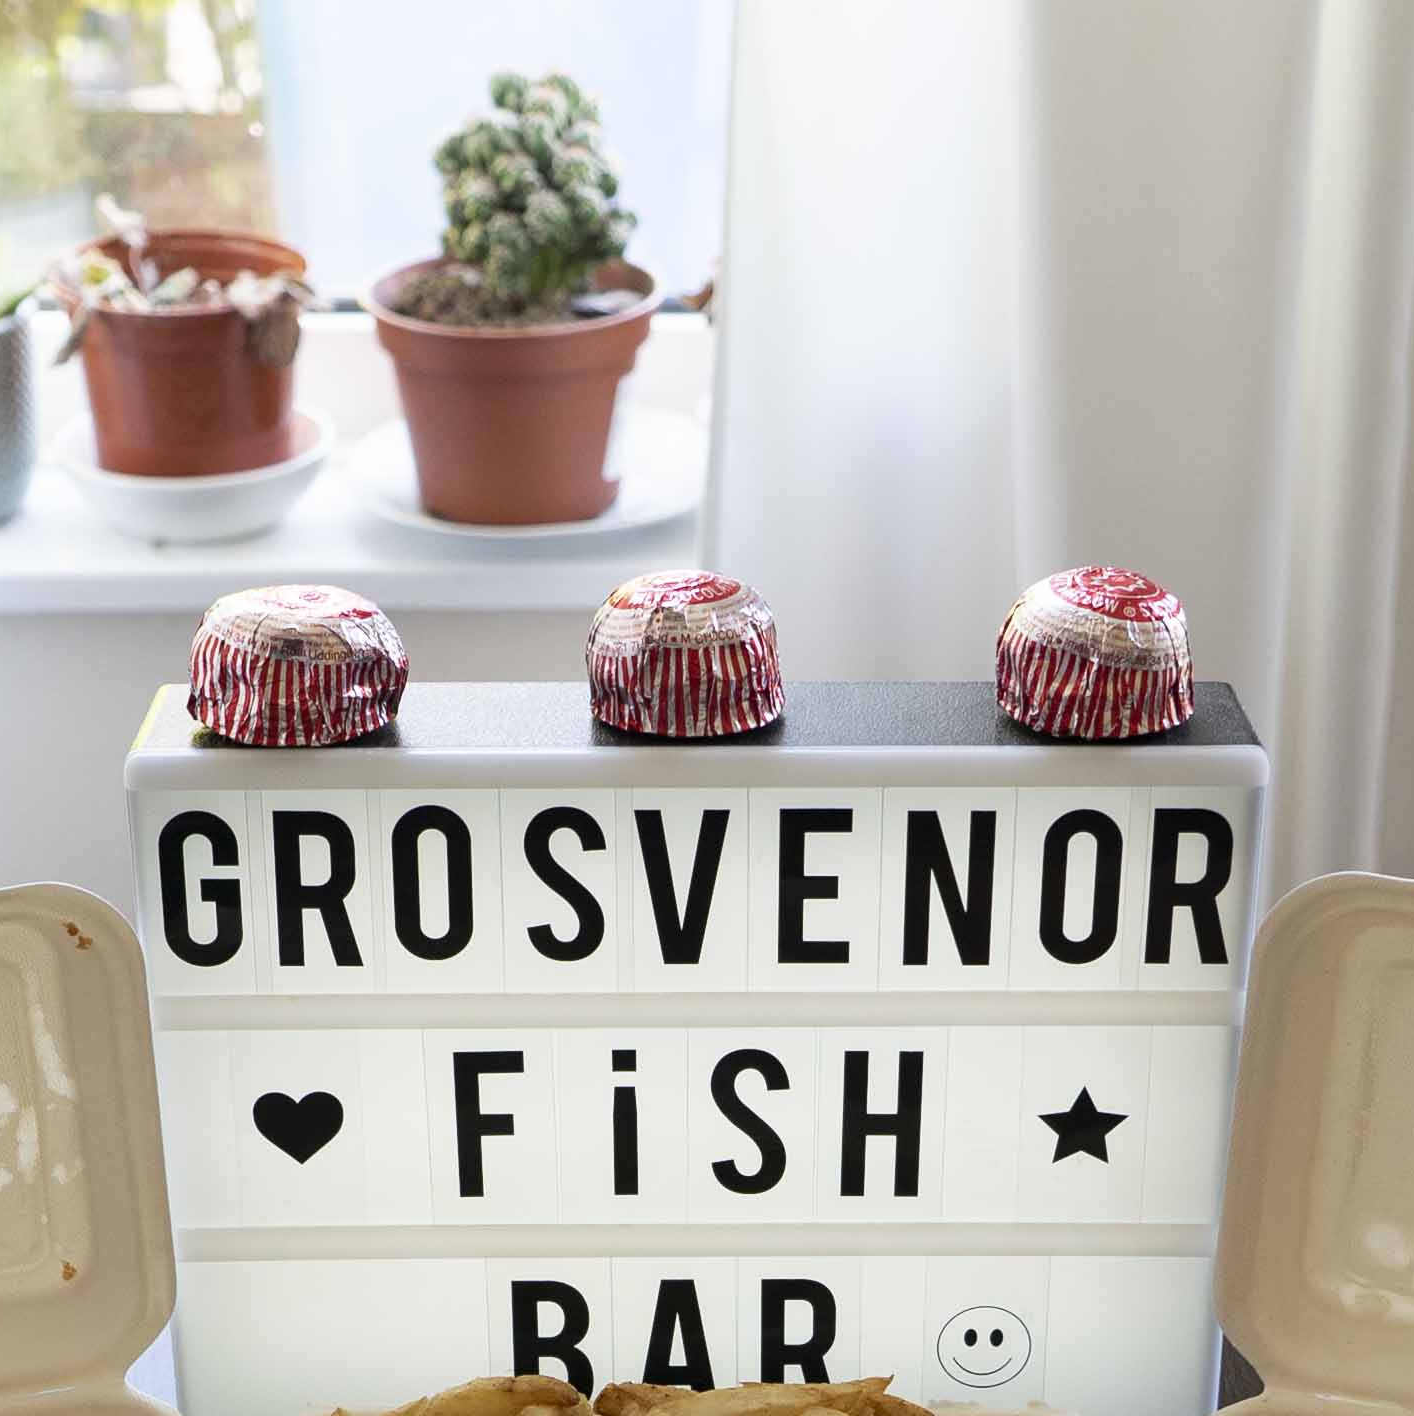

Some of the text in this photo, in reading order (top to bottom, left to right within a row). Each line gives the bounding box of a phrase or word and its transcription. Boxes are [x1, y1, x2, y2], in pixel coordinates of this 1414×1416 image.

[157, 804, 1235, 968] GROSVENOR
[453, 1047, 927, 1197] FiSH
[511, 1278, 839, 1398] BAR
